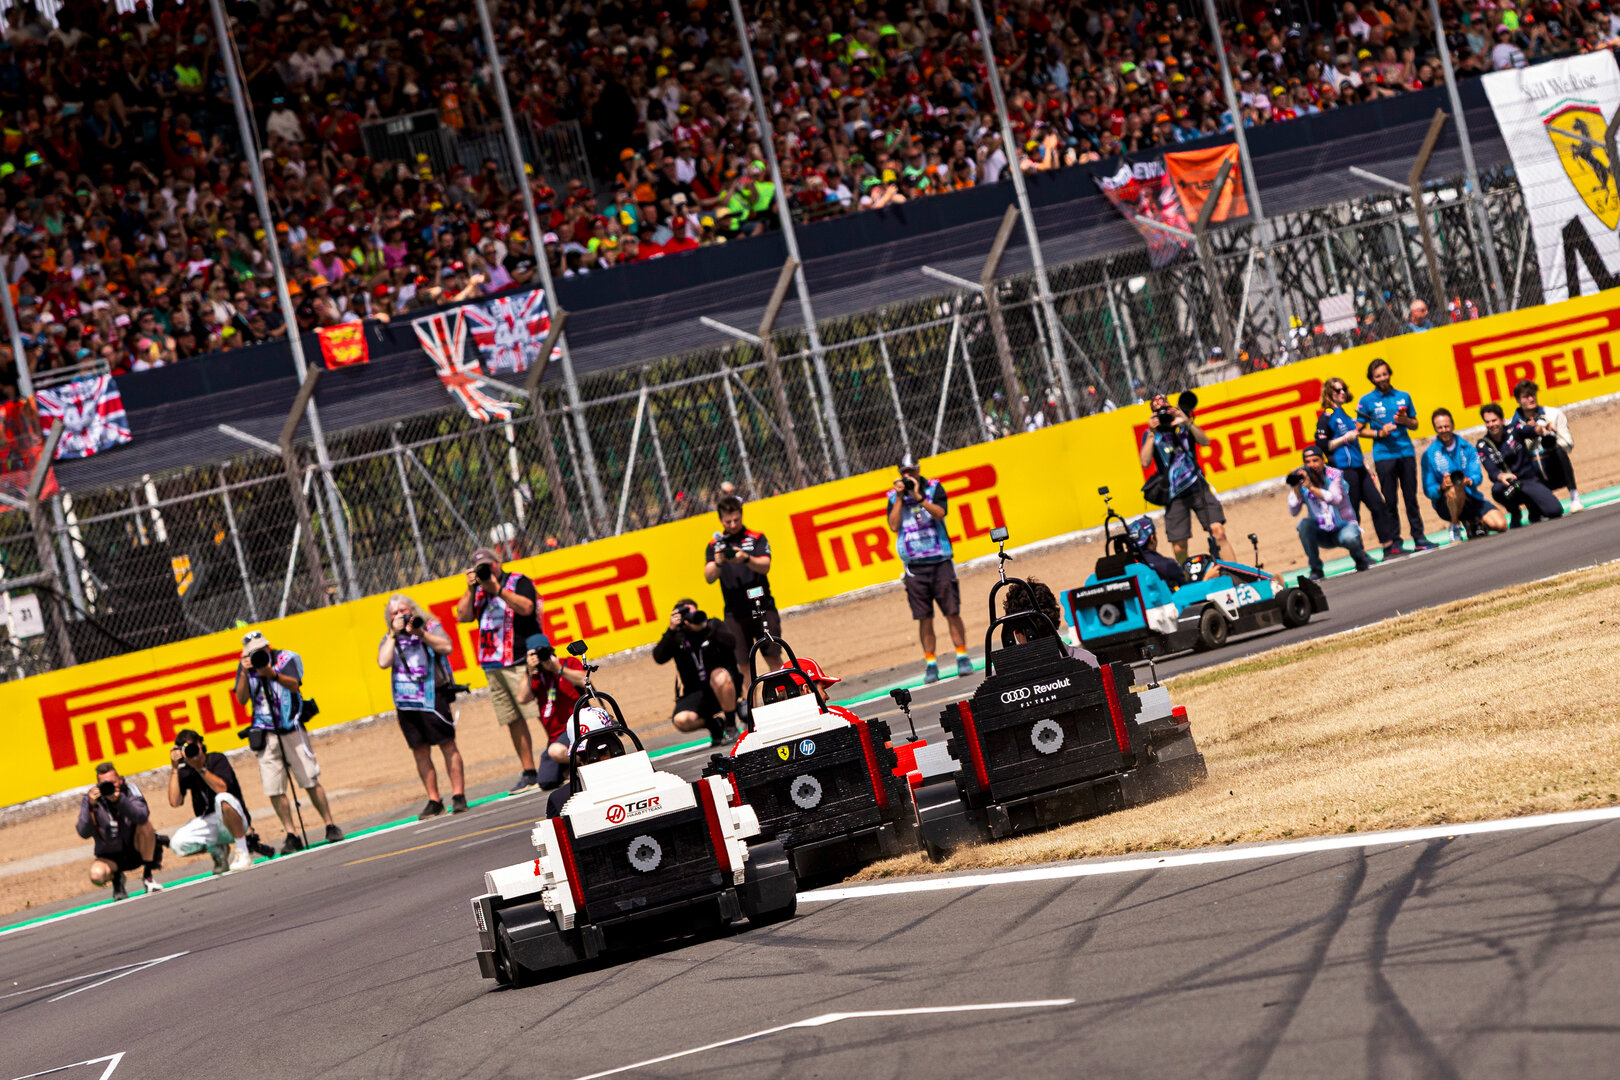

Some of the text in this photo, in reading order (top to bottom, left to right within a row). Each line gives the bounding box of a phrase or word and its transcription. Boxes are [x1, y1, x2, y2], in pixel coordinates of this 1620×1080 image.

[1452, 306, 1620, 409] PIRELL
[1237, 584, 1259, 606] 23
[1033, 677, 1071, 695] Revolut
[1034, 695, 1057, 704] TEAM
[625, 796, 660, 812] TGR
